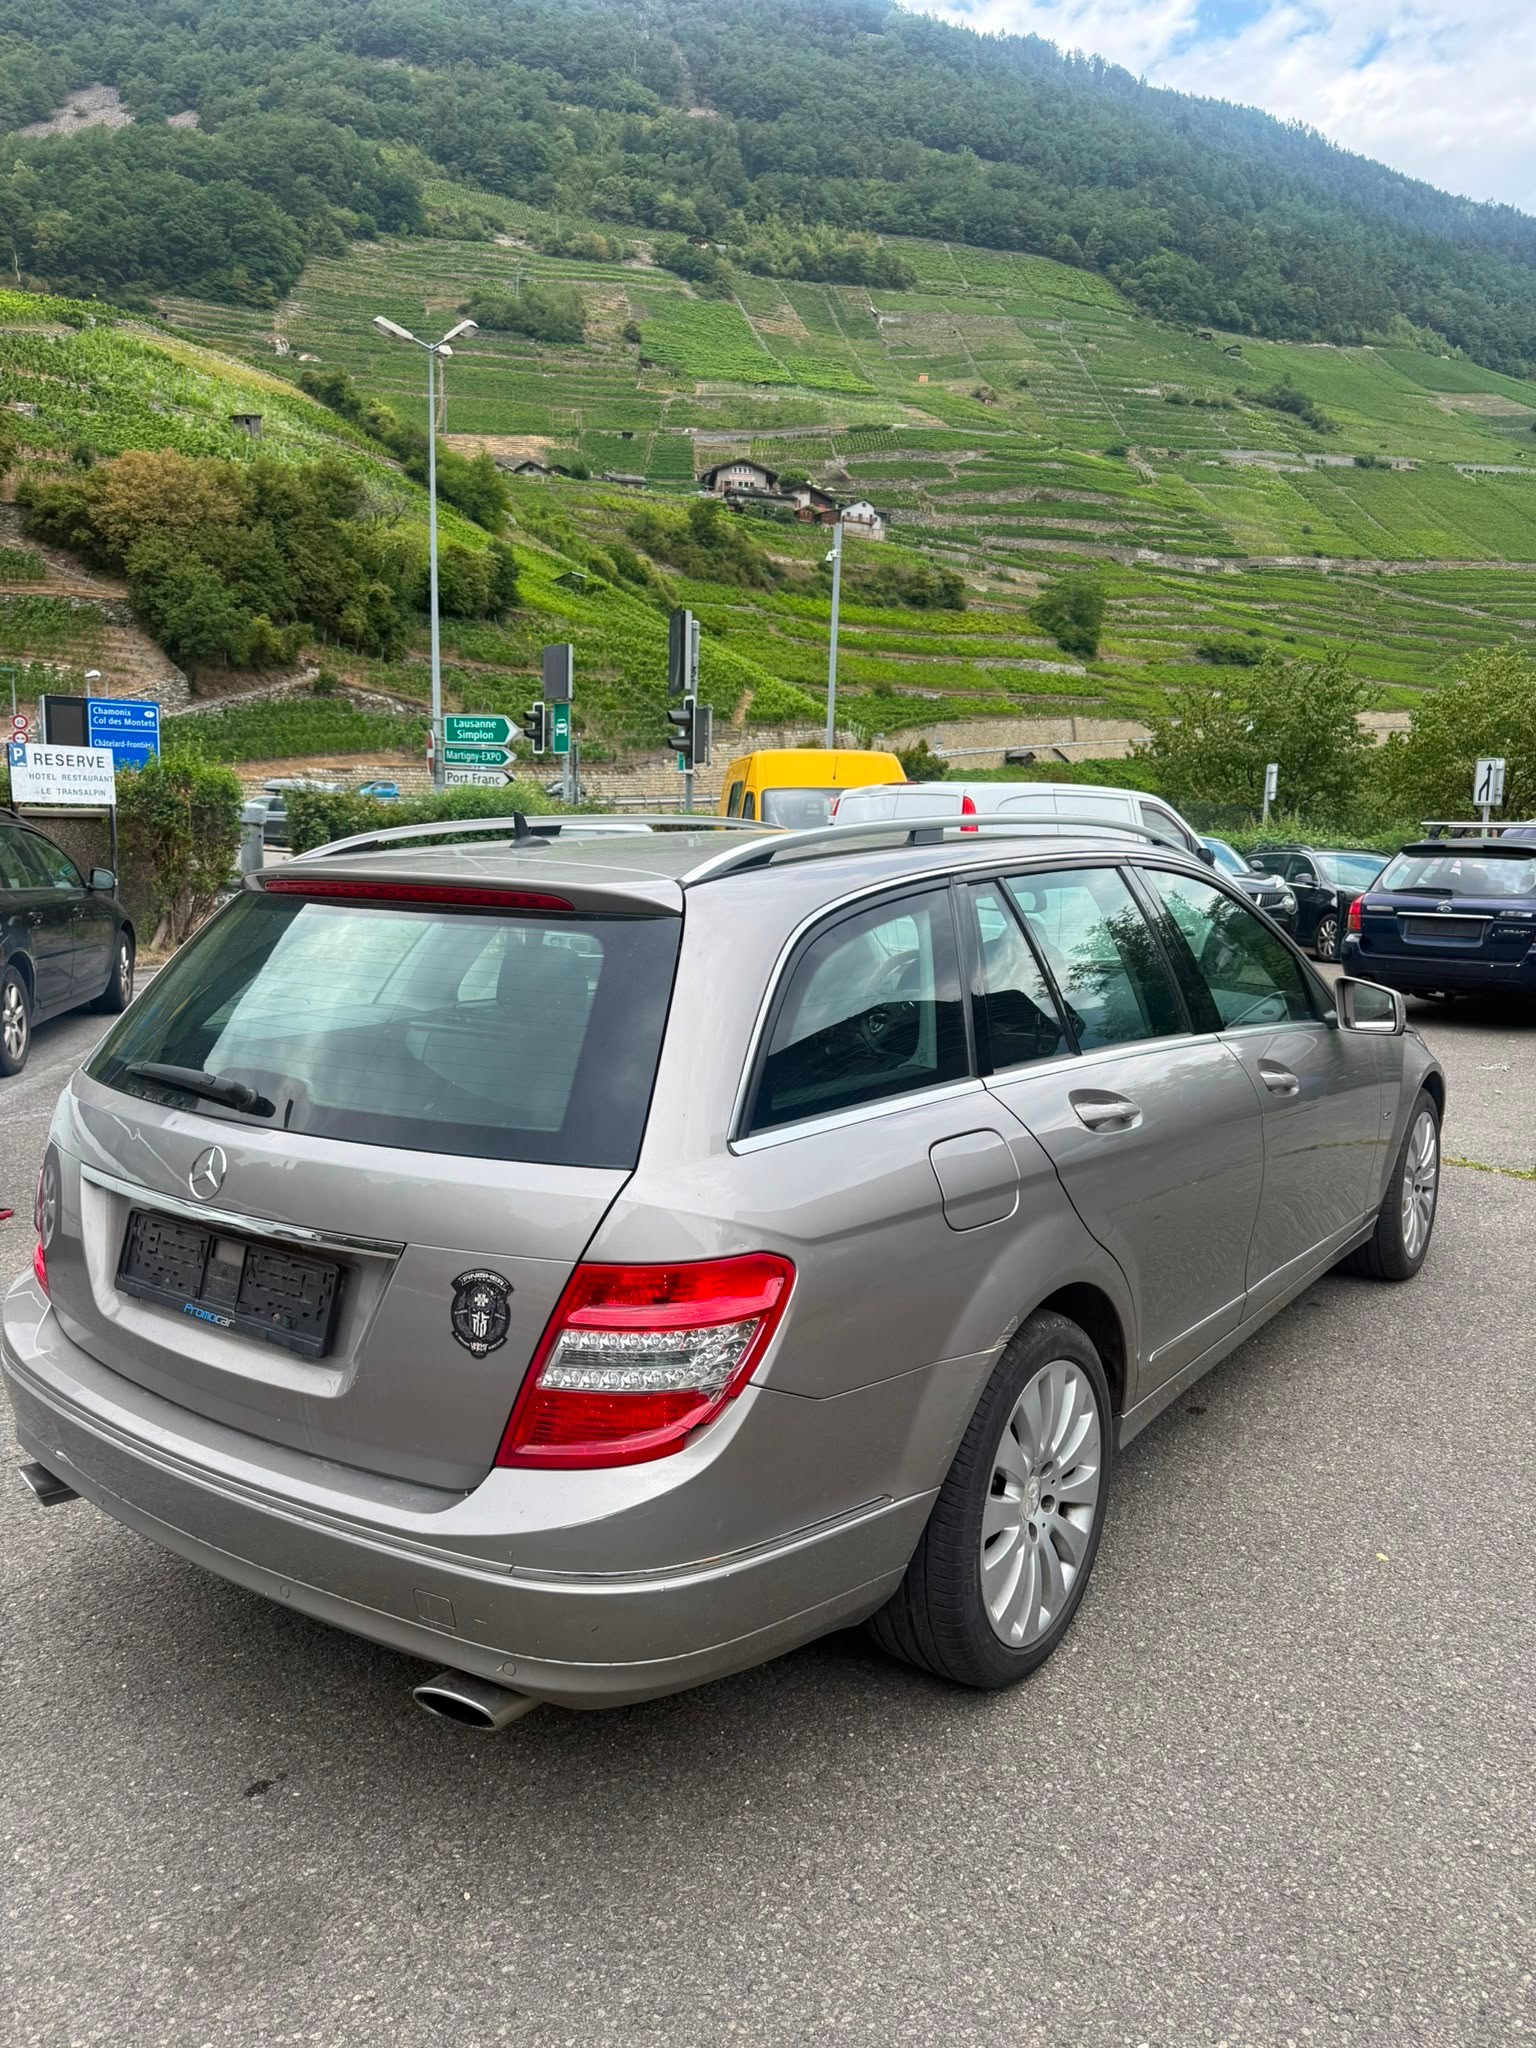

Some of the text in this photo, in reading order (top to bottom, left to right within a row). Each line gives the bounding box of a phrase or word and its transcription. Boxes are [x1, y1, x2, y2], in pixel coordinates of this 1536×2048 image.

[92, 706, 132, 716] Chamonix
[92, 716, 155, 727] Col des Montets
[453, 718, 497, 728] Lausanne
[456, 729, 494, 741] Simplon
[13, 748, 105, 768] P RESERVE
[446, 750, 502, 763] Martigny-EXPO
[29, 773, 114, 783] HOTEL RESTAURANT
[447, 772, 501, 785] Port Franc
[41, 787, 106, 796] LE TRANSALPIN
